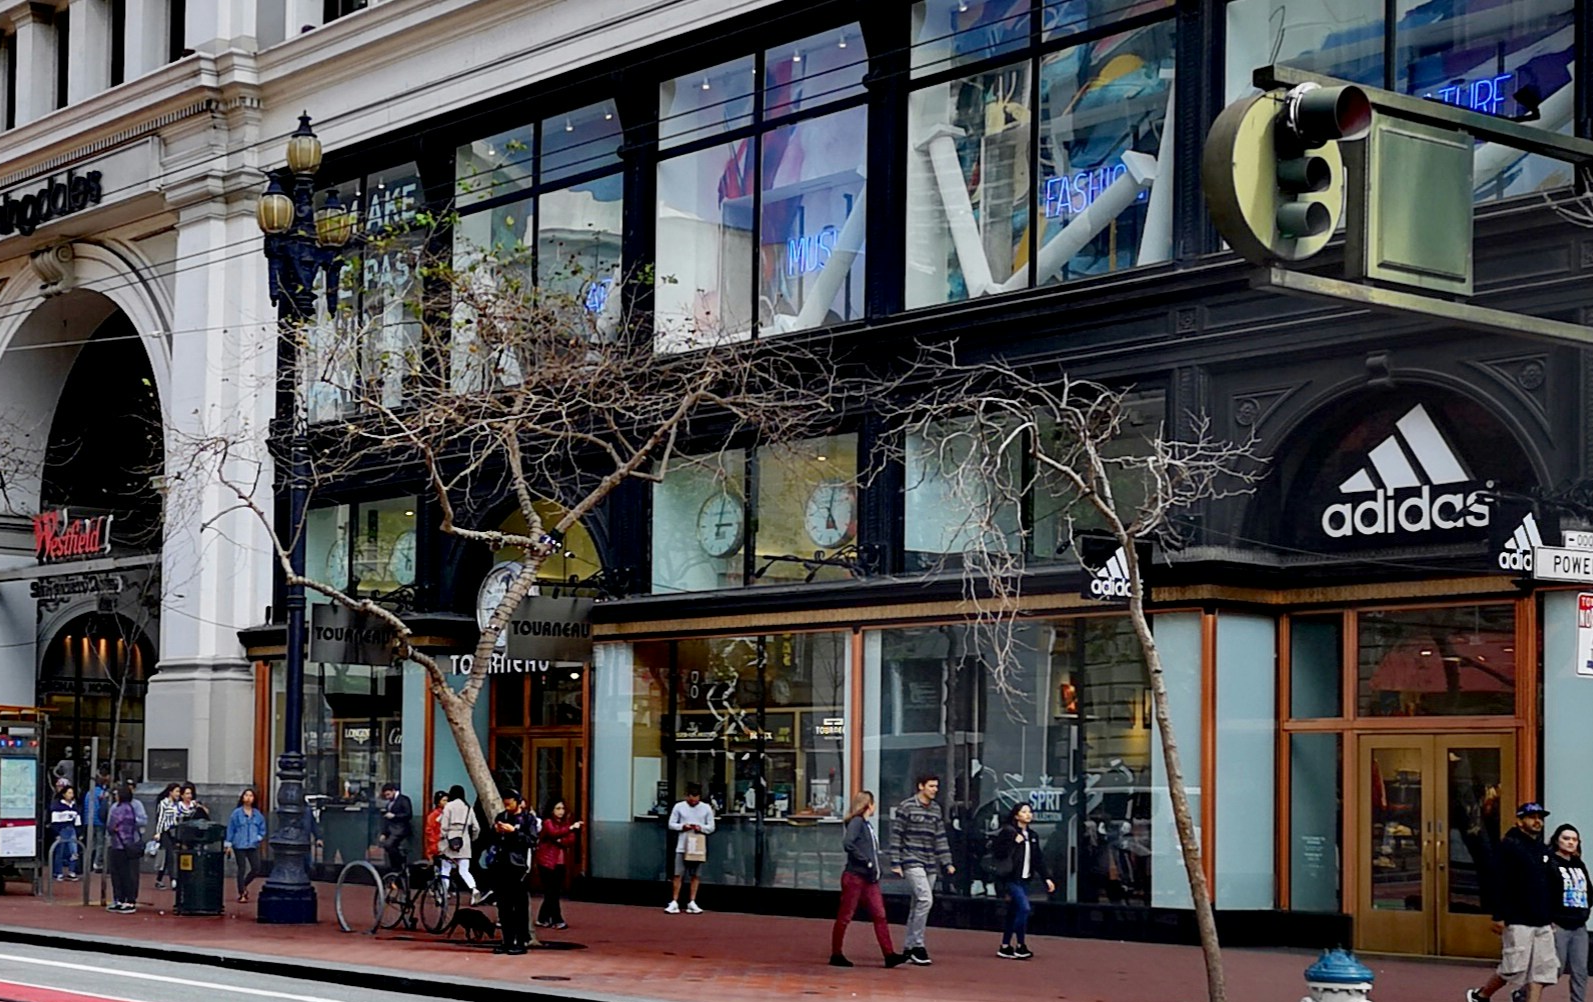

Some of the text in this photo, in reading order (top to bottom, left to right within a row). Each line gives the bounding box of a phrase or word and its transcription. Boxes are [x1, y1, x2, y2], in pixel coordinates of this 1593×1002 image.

[1045, 163, 1130, 218] FASHIO
[787, 229, 839, 277] MUS
[1322, 484, 1490, 538] adidas
[33, 509, 108, 561] Westfield
[1498, 547, 1533, 571] adid
[1553, 555, 1593, 575] POWE
[1090, 578, 1134, 597] adida
[511, 619, 591, 639] TOURNEAU
[450, 654, 550, 676] TORNEAU
[1029, 790, 1062, 811] SPRT
[1032, 811, 1062, 821] OLLECTION
